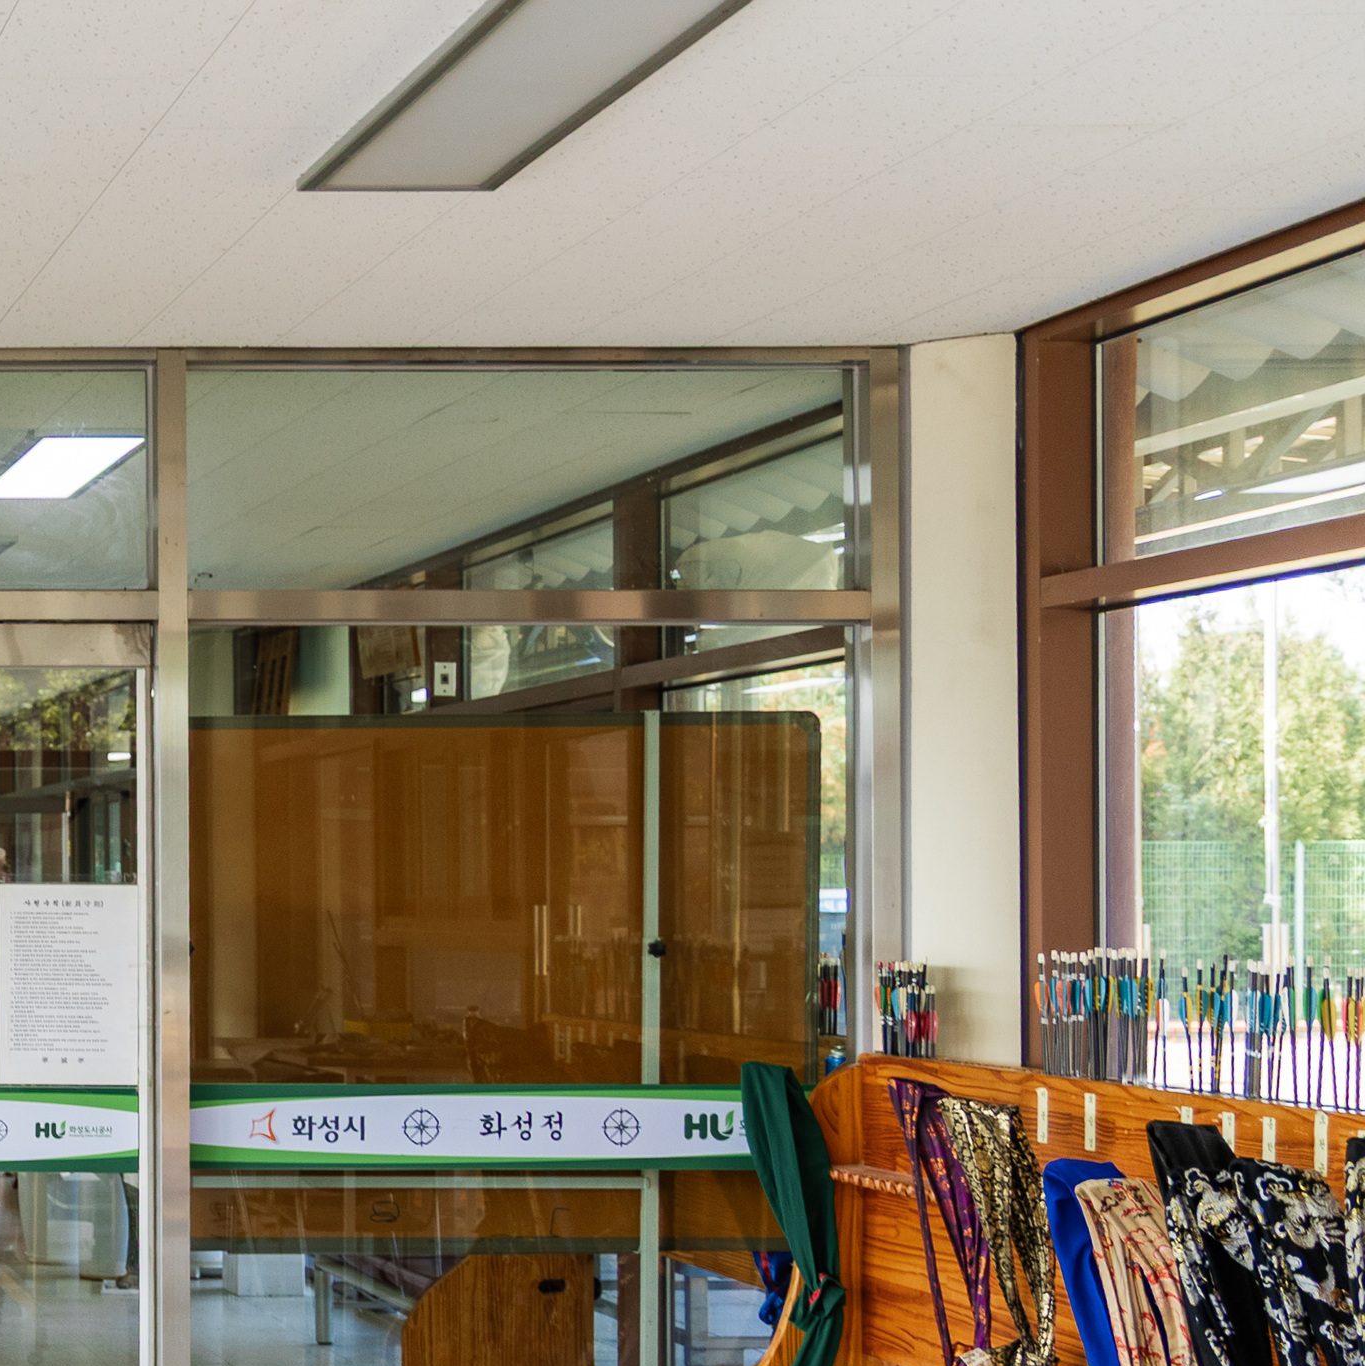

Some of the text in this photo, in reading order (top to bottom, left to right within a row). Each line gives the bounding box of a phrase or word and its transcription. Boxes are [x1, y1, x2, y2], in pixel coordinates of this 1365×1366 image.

[35, 1120, 66, 1139] HU
[68, 1125, 113, 1134] 화성도시공사
[291, 1110, 564, 1143] 화성시 화성정
[684, 1109, 734, 1141] HU
